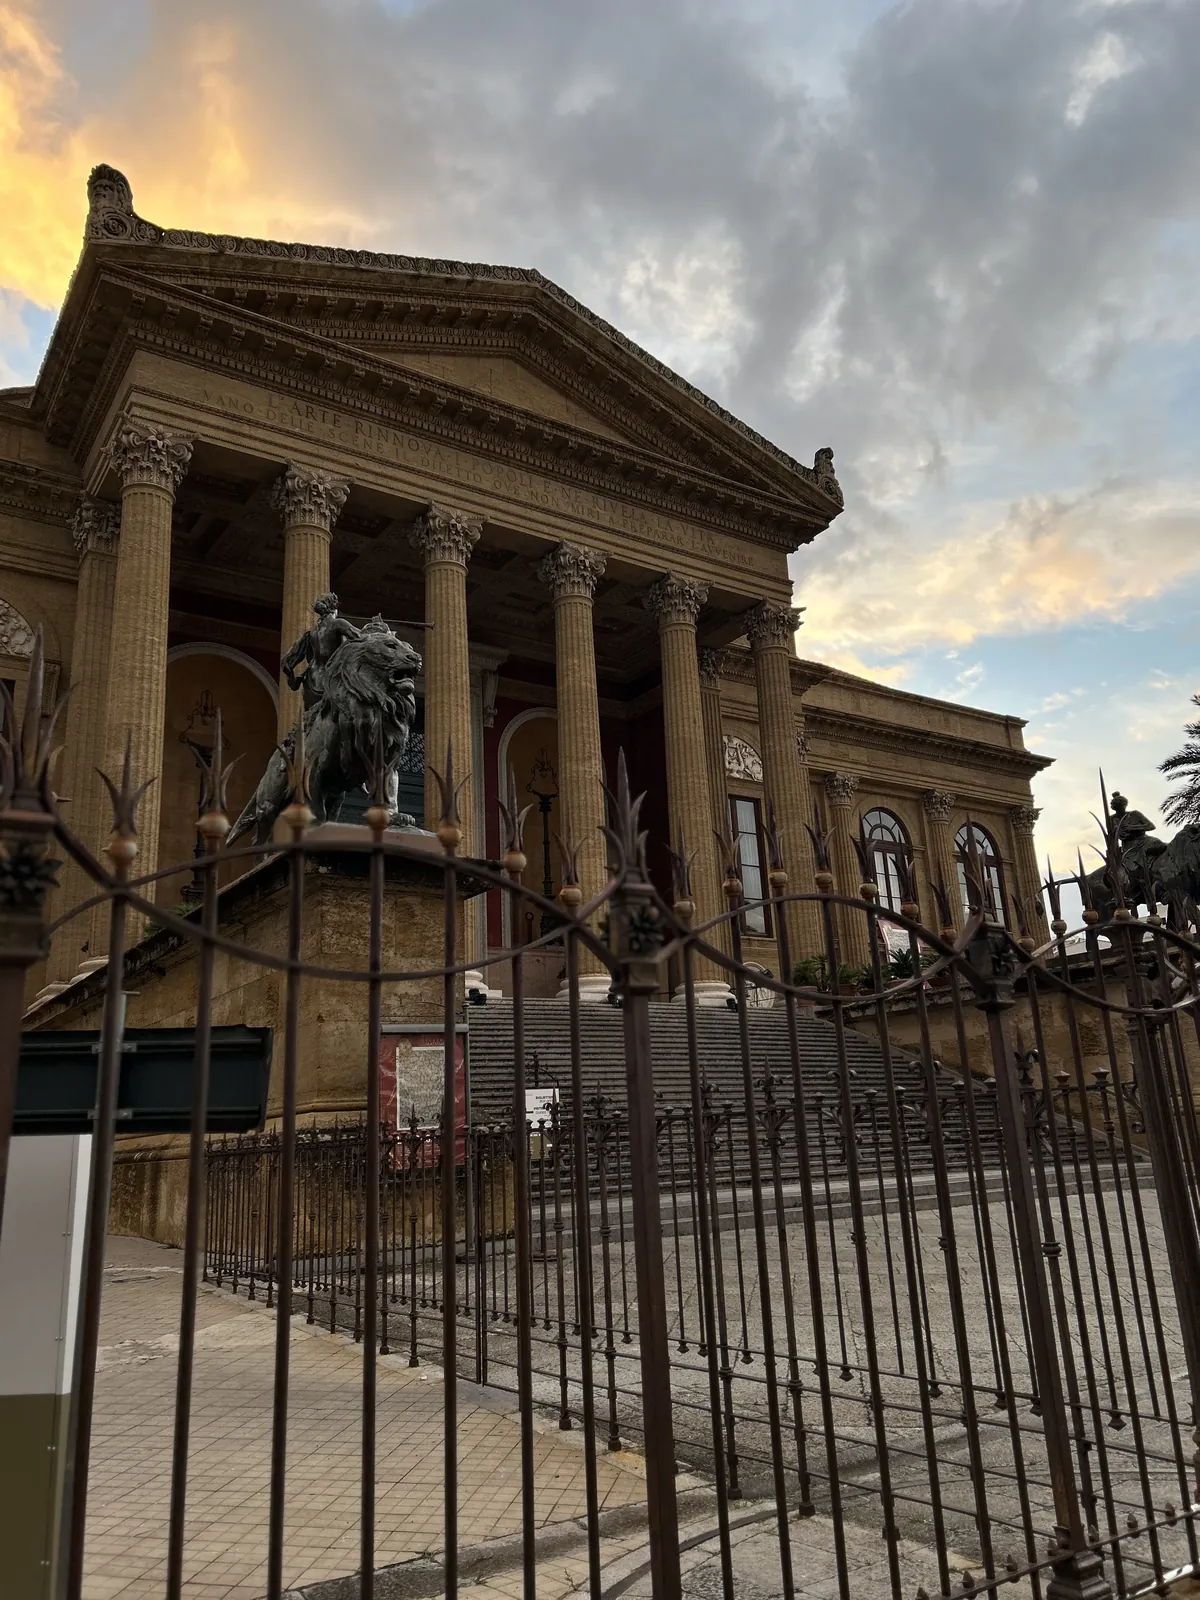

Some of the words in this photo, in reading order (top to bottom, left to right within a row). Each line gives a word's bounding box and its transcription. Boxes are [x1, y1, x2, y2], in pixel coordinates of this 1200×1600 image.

[204, 390, 254, 414] VANO
[266, 409, 314, 433] DELLE
[328, 428, 384, 454] SCENE
[421, 457, 482, 483] DILETTO
[530, 490, 560, 508] NON
[571, 503, 600, 520] MIRI
[622, 519, 685, 545] PREPARAR
[355, 420, 444, 460] RINNOVA
[472, 457, 533, 488] POPOLI
[543, 480, 552, 493] E
[561, 487, 581, 502] NE
[592, 496, 649, 525] RIVELA
[657, 517, 674, 533] LA
[681, 525, 716, 545] VITA
